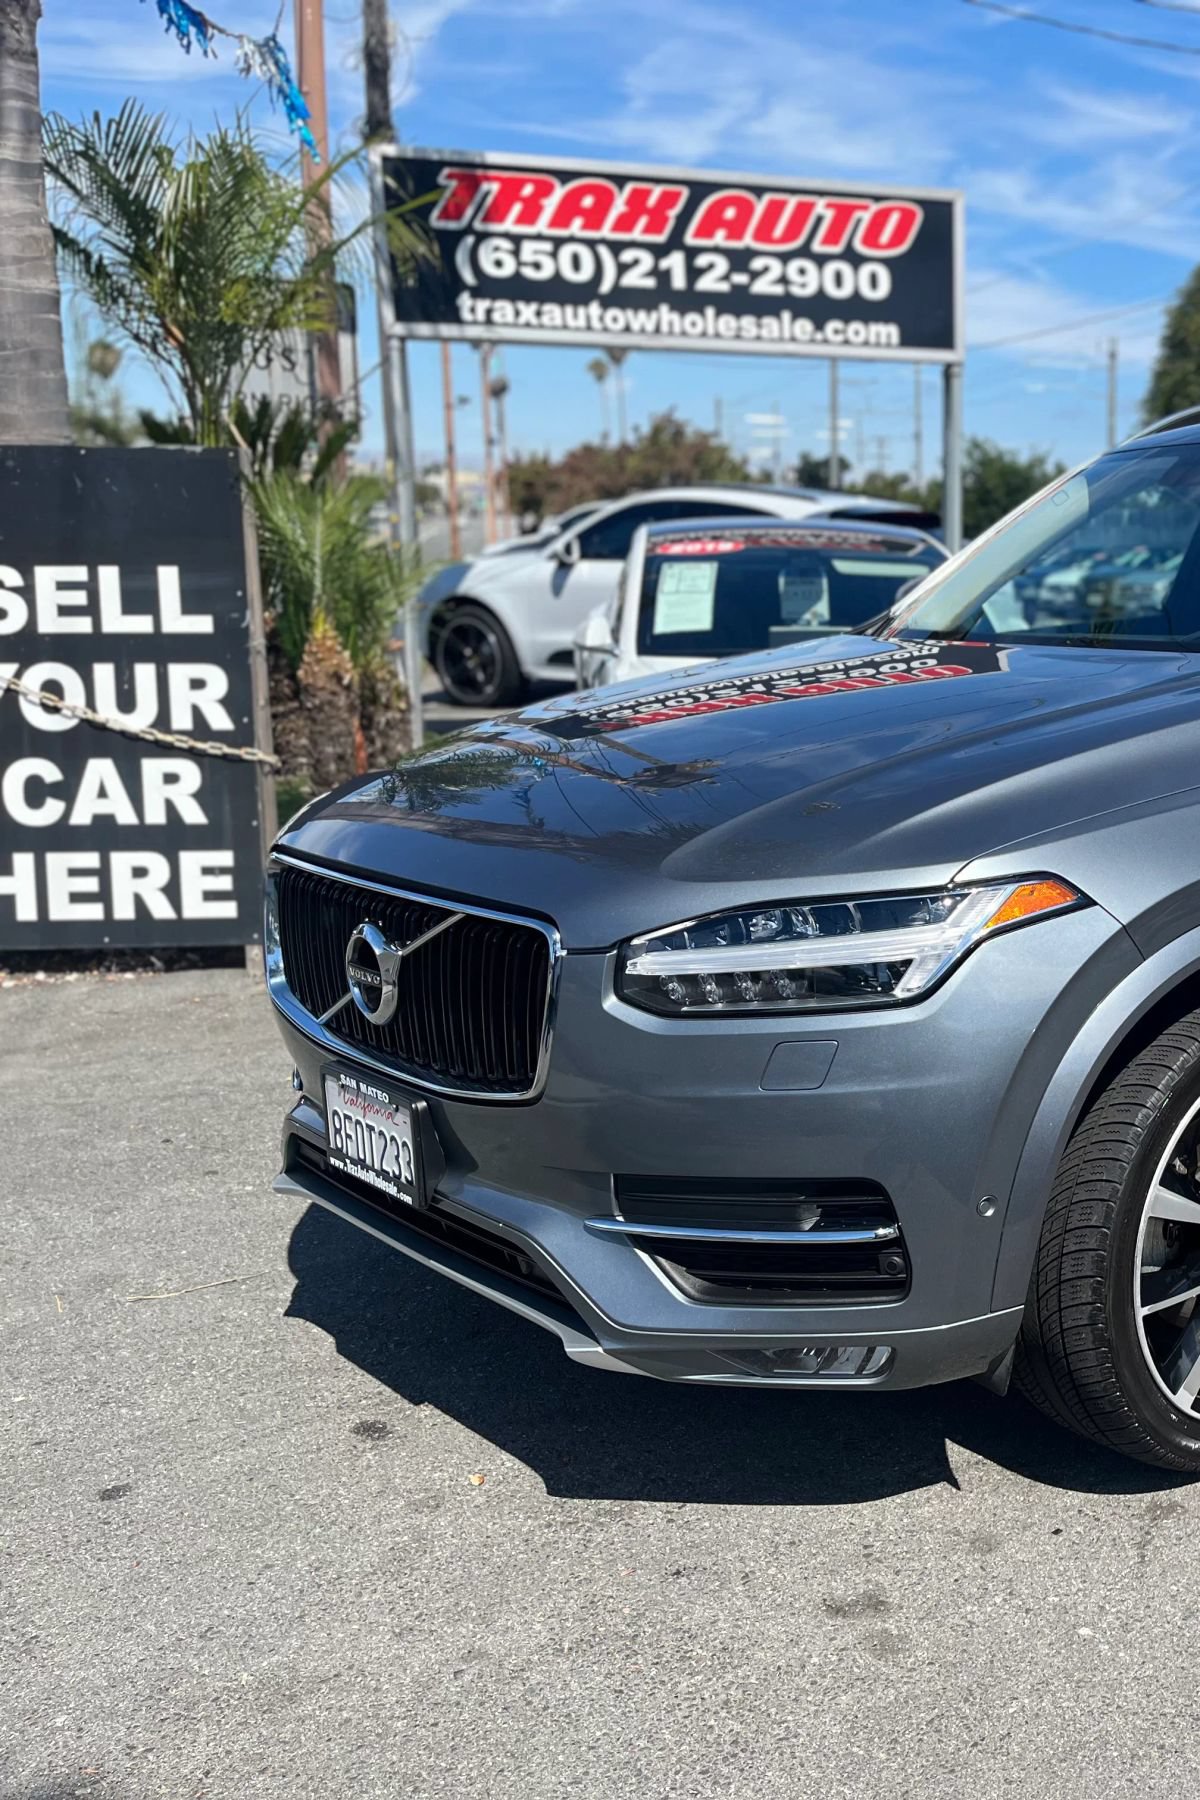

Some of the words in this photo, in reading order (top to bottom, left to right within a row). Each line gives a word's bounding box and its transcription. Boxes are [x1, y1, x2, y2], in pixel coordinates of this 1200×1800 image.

[430, 167, 689, 239] TRAX
[684, 188, 924, 256] AUTO
[455, 239, 892, 301] (650)212-2900
[457, 290, 900, 347] traxautowholesale.com
[2, 757, 208, 827] CAR
[349, 966, 381, 985] VOLVO
[340, 1074, 357, 1090] SAN
[360, 1082, 389, 1103] MATEO
